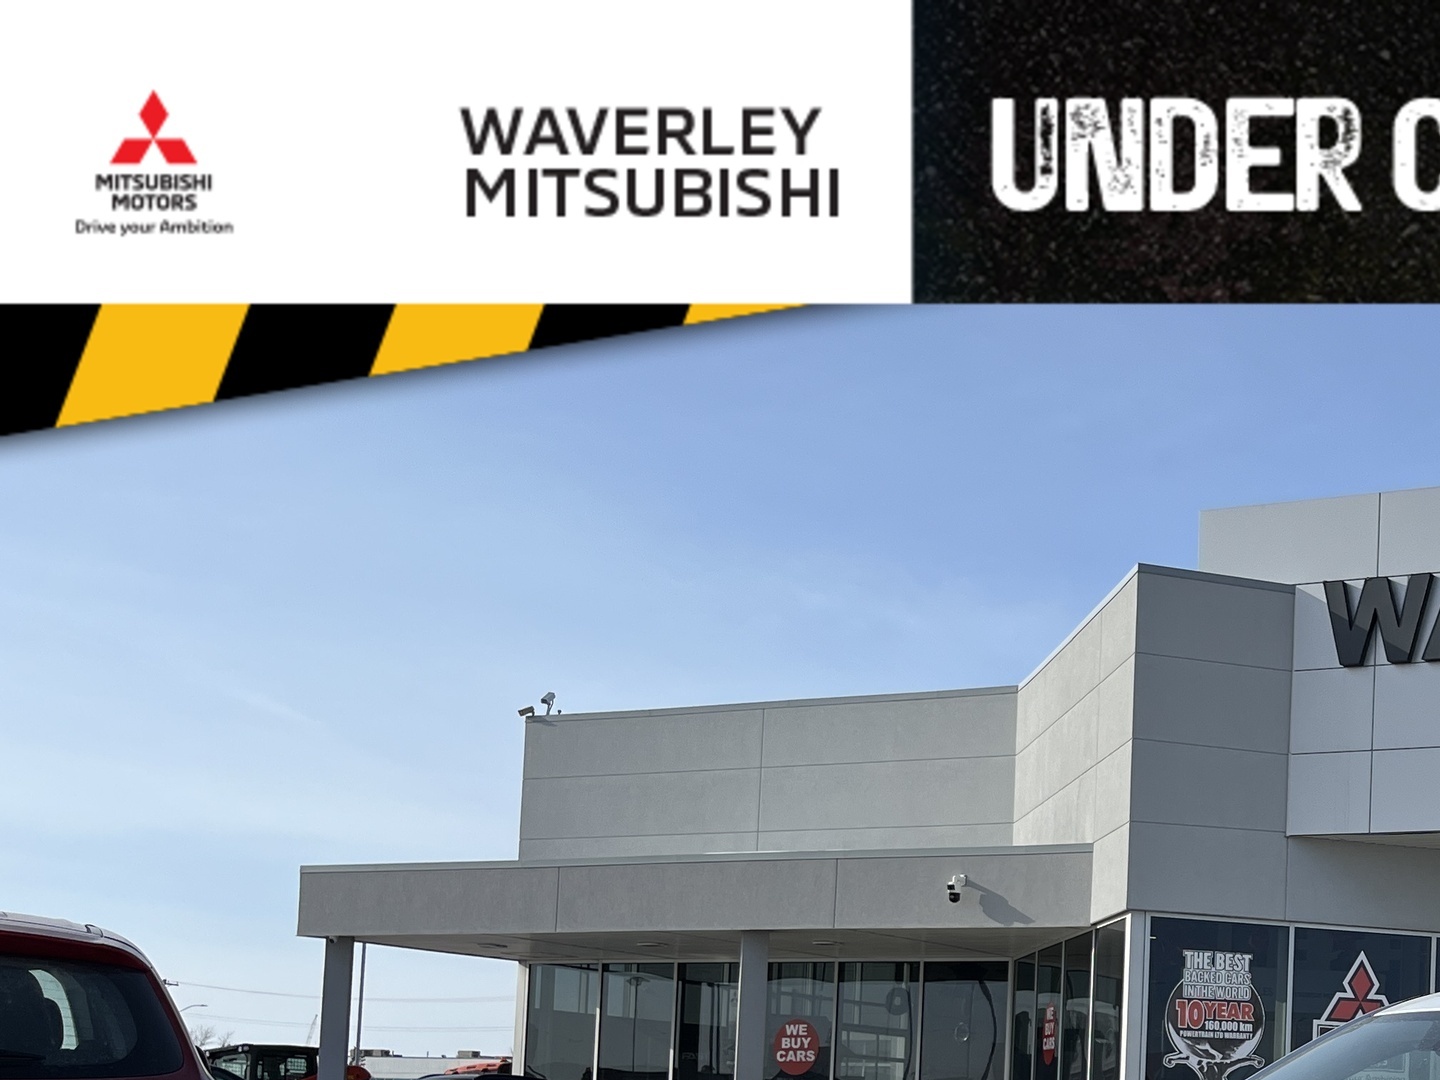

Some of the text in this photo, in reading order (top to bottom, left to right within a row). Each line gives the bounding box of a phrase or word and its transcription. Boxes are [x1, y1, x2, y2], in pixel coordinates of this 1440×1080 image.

[1183, 951, 1252, 972] THE BEST
[1184, 970, 1251, 986] BACKED CARS
[1216, 985, 1251, 1000] WORLD
[1203, 1001, 1254, 1021] YEAR
[785, 1024, 808, 1036] WE
[1204, 1021, 1253, 1032] 160,000 km
[781, 1037, 812, 1049] BUY
[776, 1050, 816, 1062] CARS
